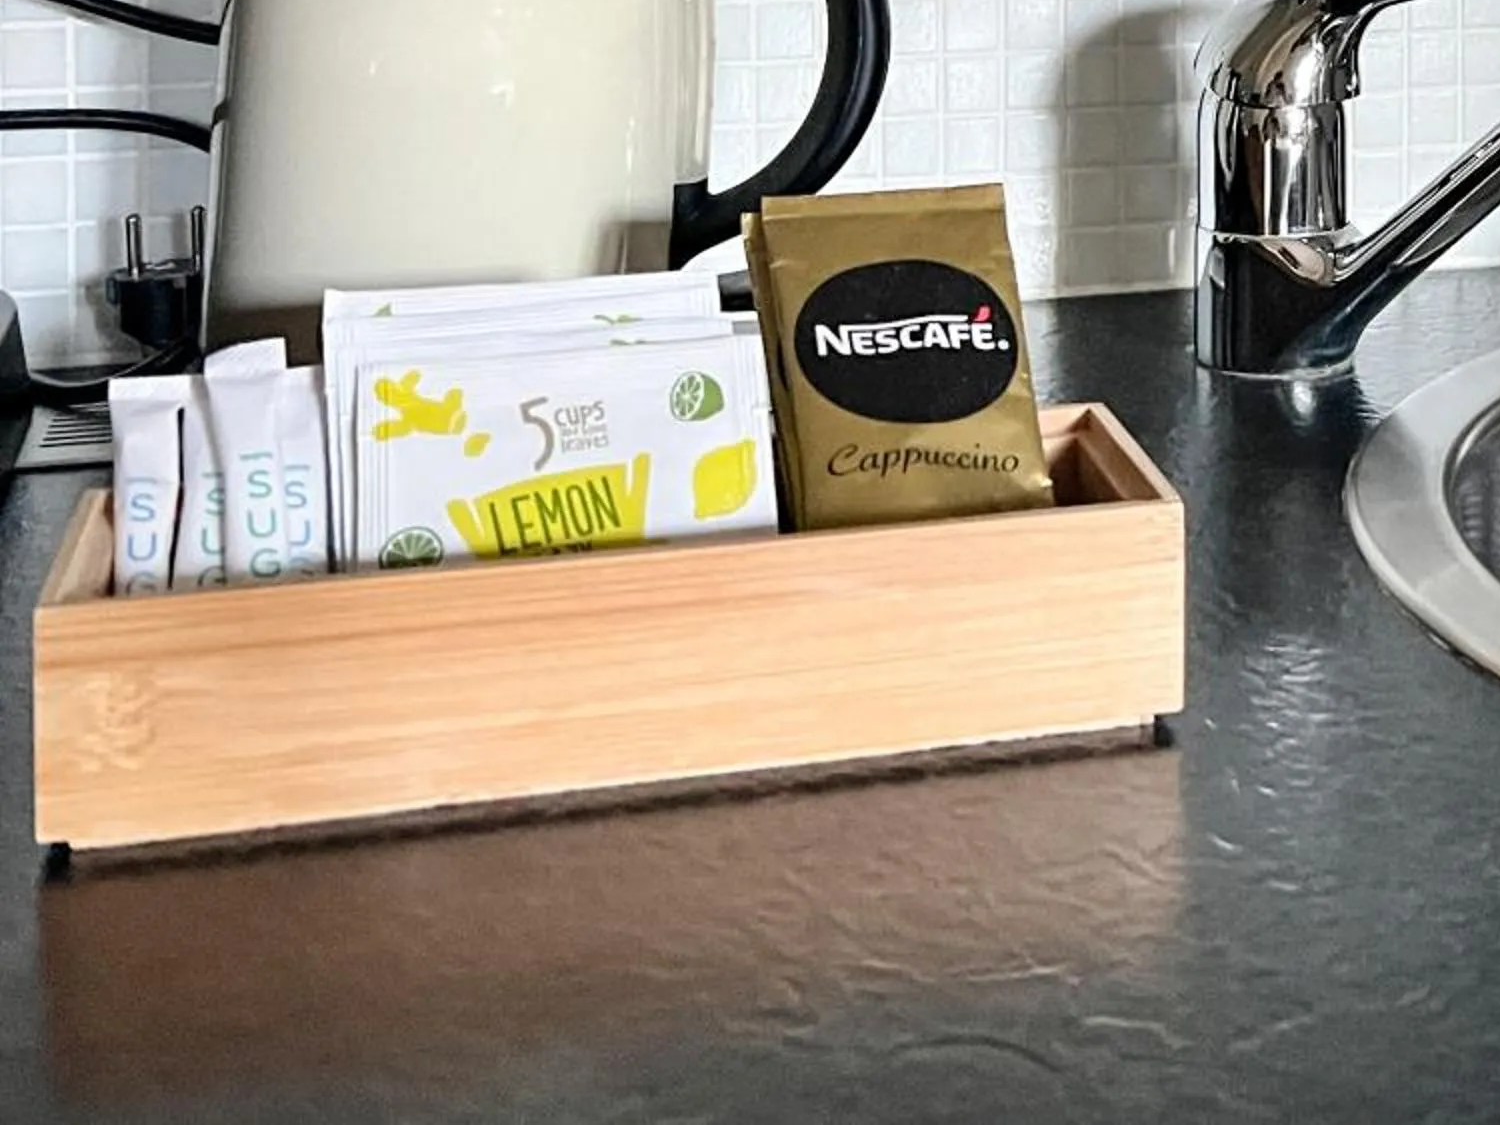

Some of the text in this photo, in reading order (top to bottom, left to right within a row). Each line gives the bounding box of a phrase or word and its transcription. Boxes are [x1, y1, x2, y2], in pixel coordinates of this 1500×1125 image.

[519, 396, 549, 471] 5
[827, 443, 1020, 479] Cappuccino
[489, 475, 621, 556] LEMON
